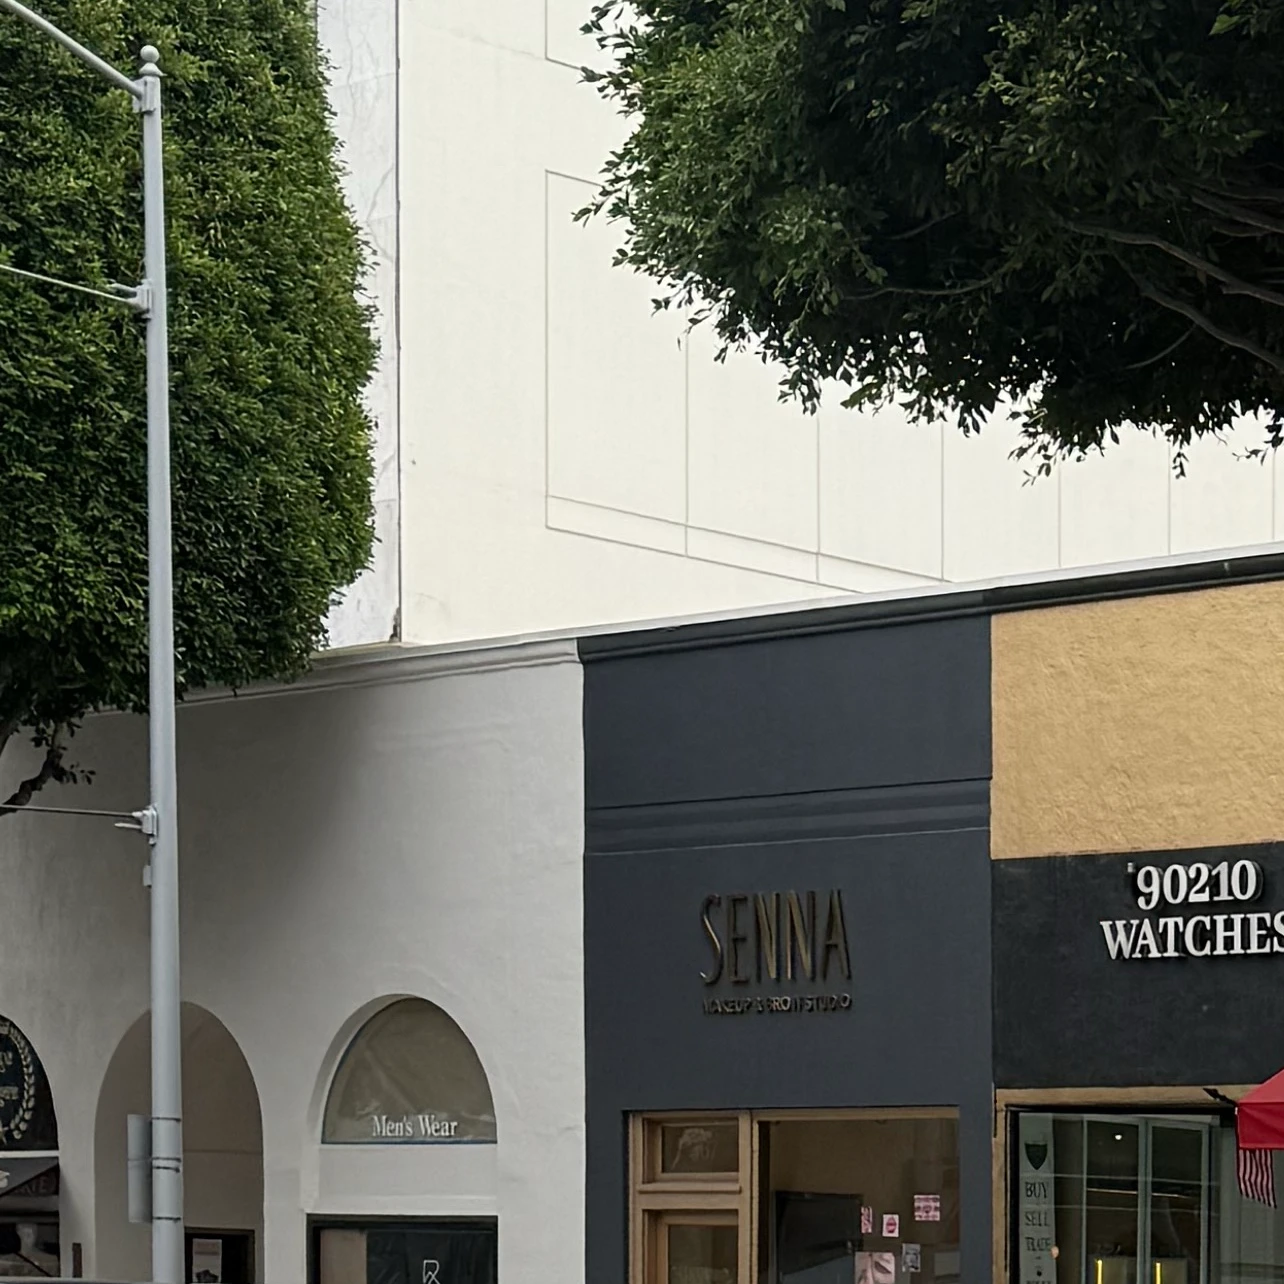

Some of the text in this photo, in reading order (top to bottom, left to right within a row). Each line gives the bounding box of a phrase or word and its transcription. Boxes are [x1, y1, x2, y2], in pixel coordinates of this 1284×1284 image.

[1136, 859, 1259, 911] 90210
[700, 888, 853, 986] SENNA
[373, 1114, 458, 1137] Men's Wear
[1025, 1182, 1048, 1198] BUY
